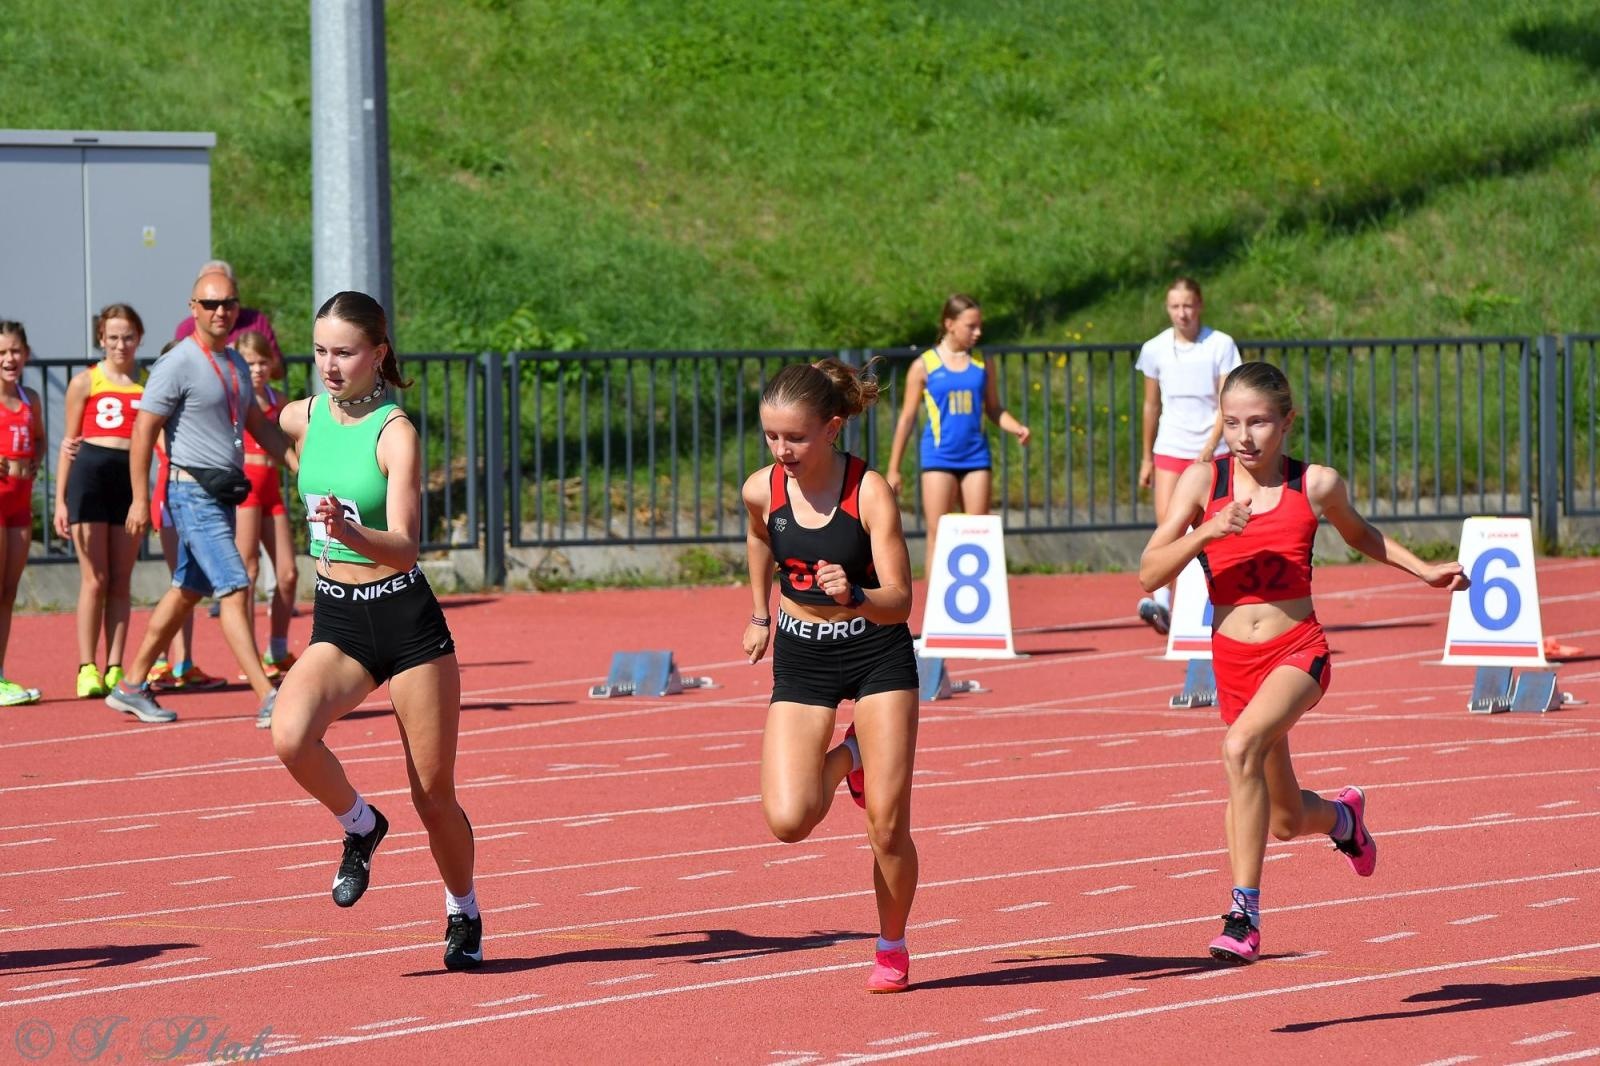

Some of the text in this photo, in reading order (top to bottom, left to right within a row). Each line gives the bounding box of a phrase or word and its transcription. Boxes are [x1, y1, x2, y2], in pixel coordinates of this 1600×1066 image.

[352, 574, 408, 601] NIKE
[944, 543, 991, 625] 8
[1236, 555, 1290, 594] 32
[1468, 547, 1522, 632] 6
[777, 606, 866, 641] NIKE PRO
